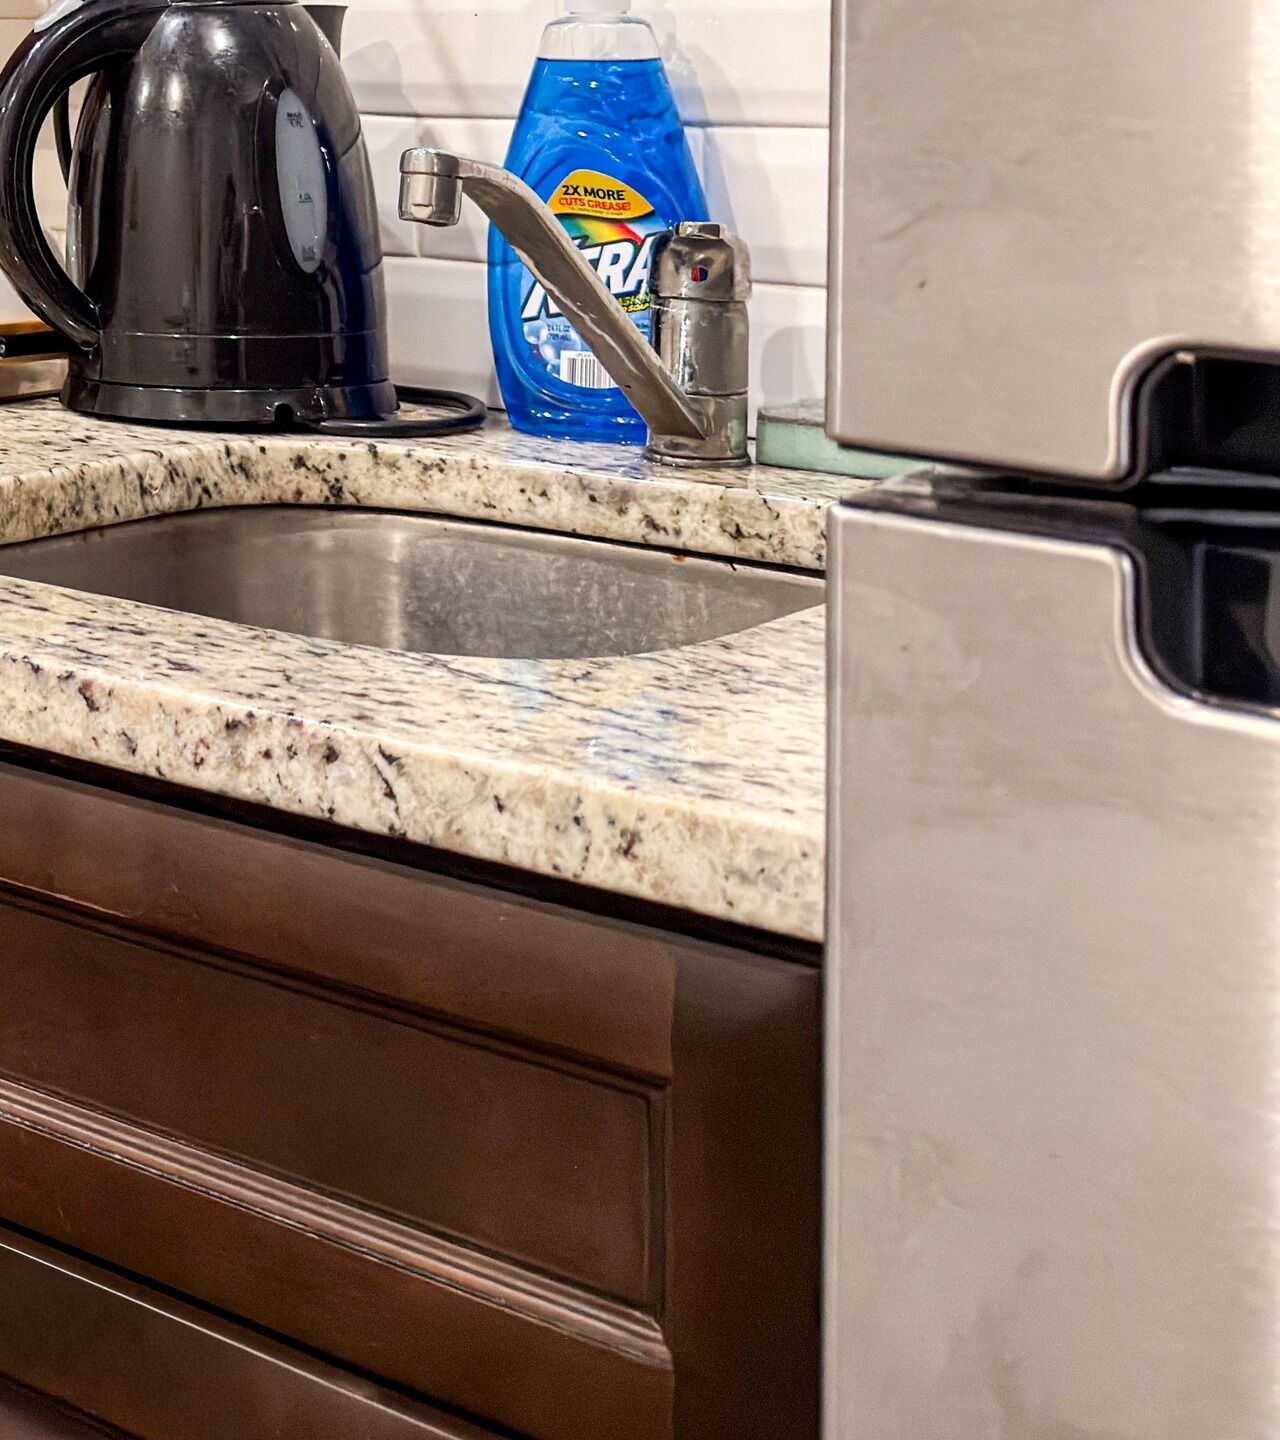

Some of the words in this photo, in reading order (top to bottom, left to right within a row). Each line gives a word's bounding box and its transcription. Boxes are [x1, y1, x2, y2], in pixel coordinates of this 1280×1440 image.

[562, 185, 580, 196] 2X
[583, 187, 625, 201] MORE
[558, 197, 585, 207] CUTS
[587, 200, 631, 211] GREASE!
